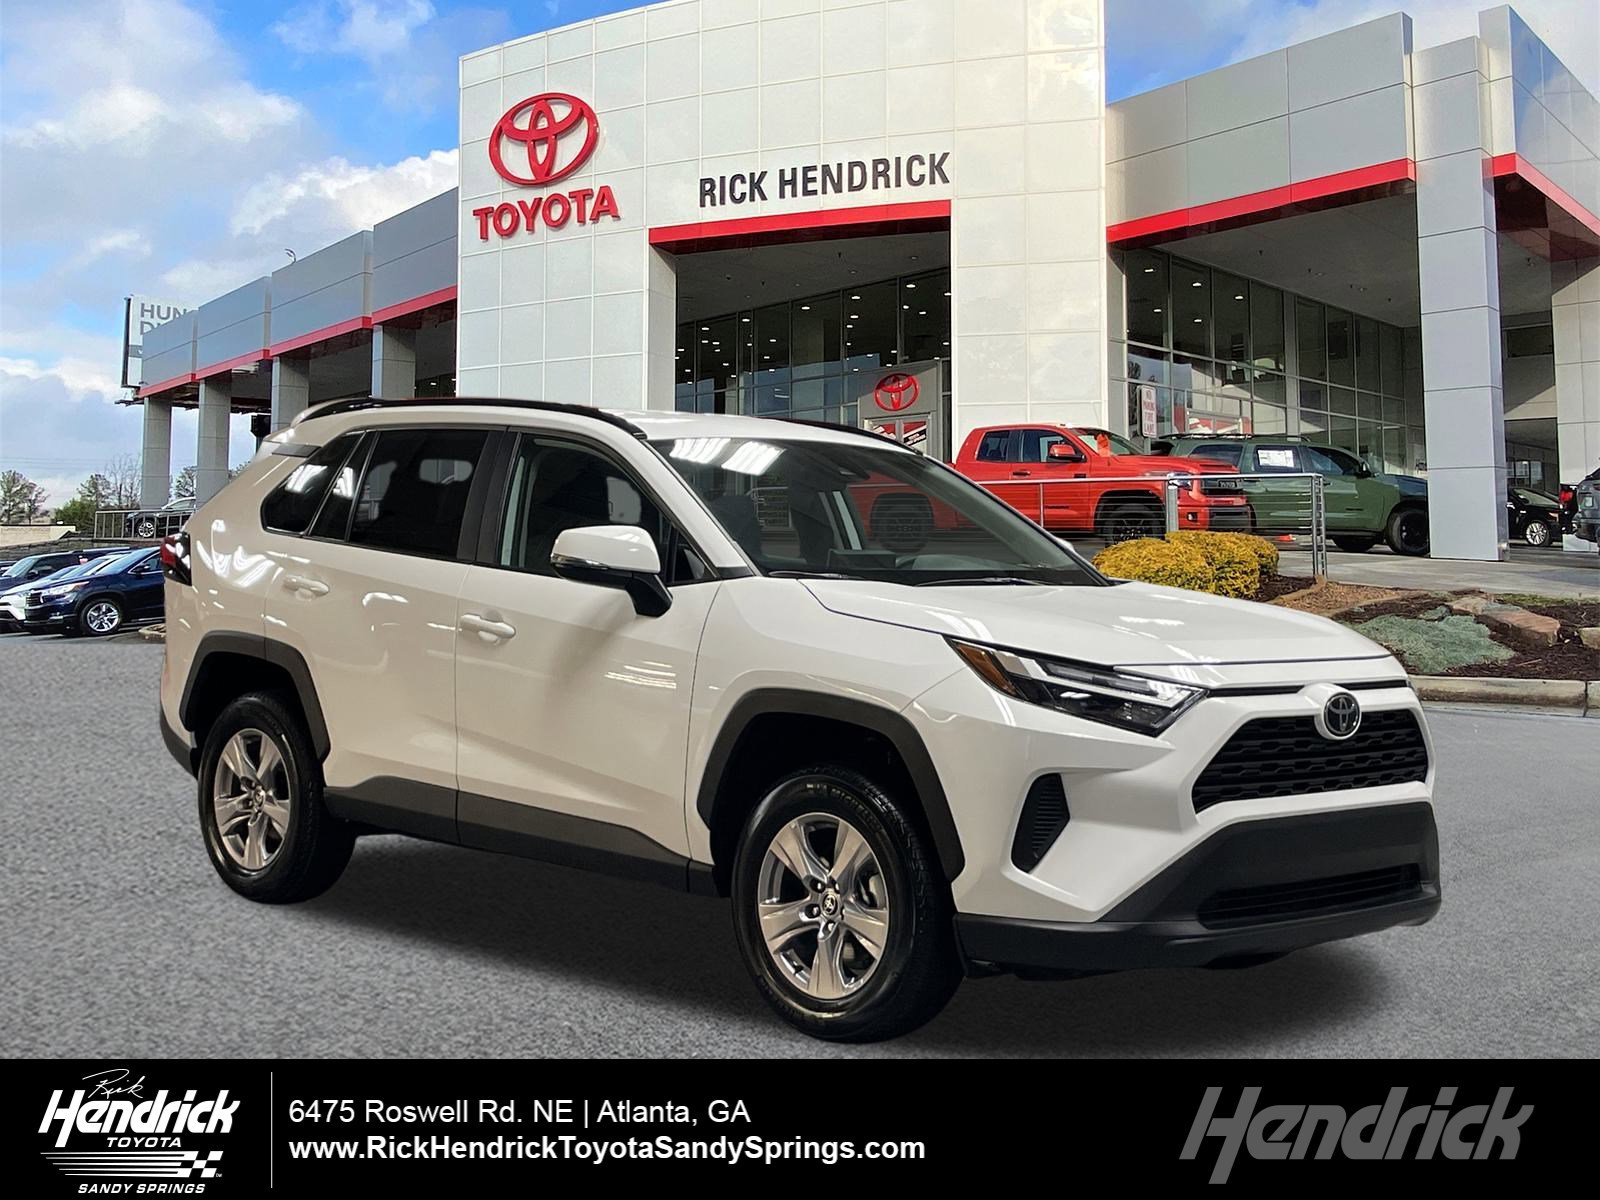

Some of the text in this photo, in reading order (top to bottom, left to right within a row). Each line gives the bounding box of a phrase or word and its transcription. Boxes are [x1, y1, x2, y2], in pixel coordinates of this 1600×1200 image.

[699, 152, 951, 208] RICK HENDRICK
[472, 185, 620, 241] TOYOTA
